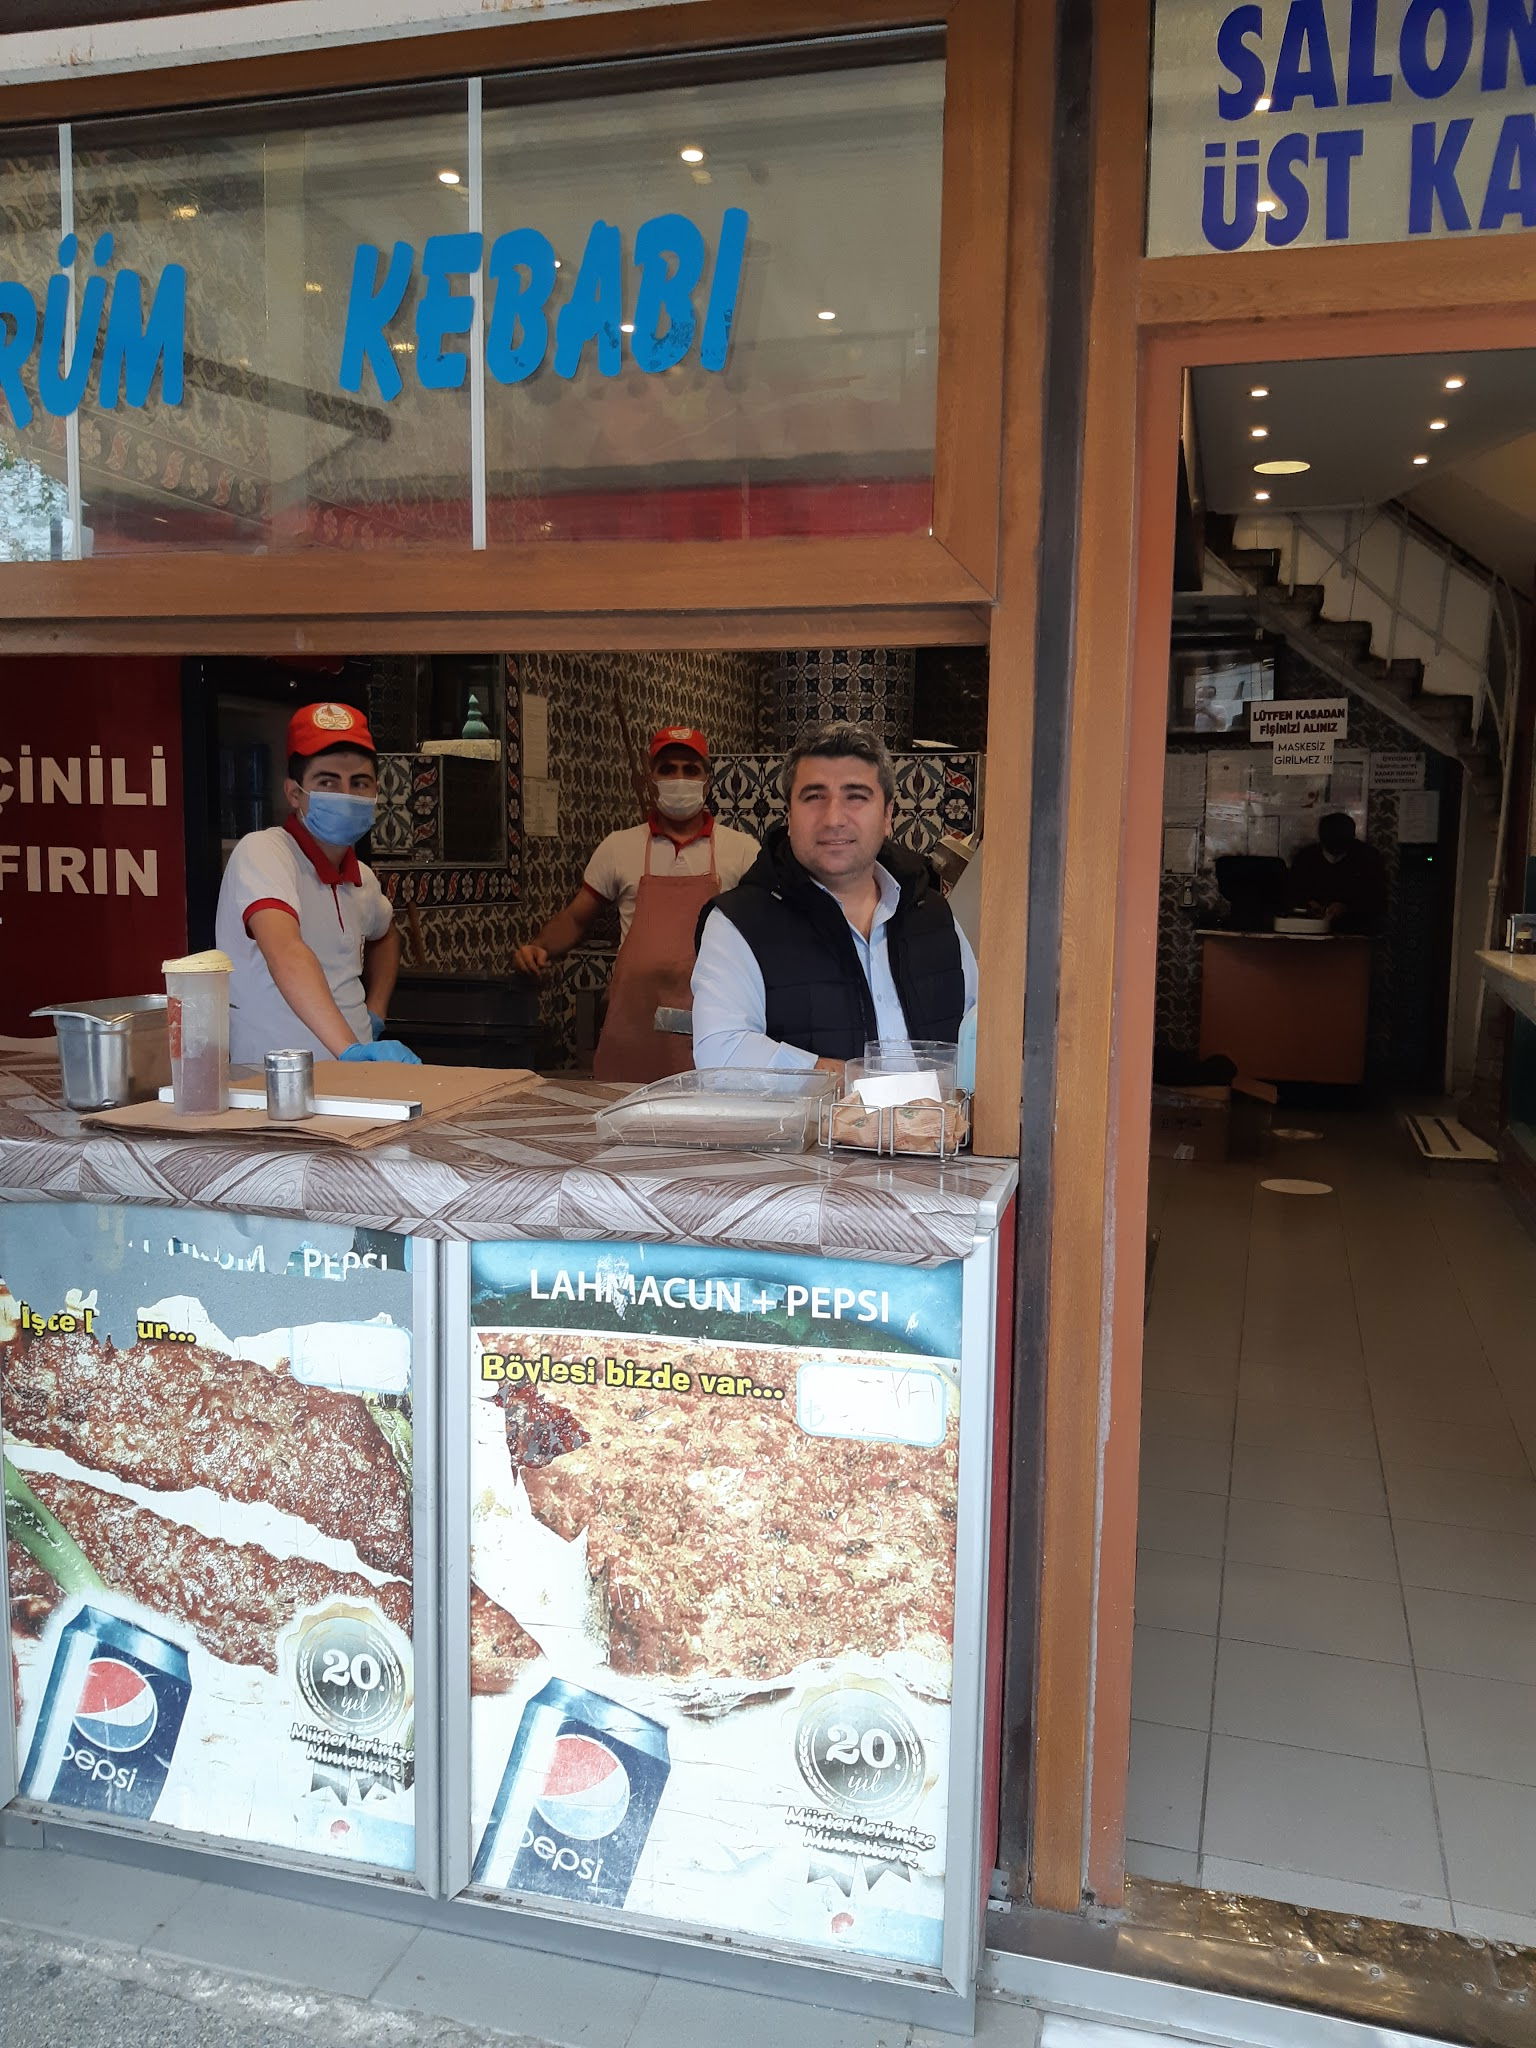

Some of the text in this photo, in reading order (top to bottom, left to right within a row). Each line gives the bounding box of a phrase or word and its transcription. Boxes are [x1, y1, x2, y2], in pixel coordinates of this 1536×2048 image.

[1202, 129, 1364, 252] ÜST
[339, 207, 749, 401] KEBABI
[1253, 708, 1345, 721] LÜTFEN KASADAN
[1260, 722, 1338, 737] FİŞİNİZİ ALINIZ
[1274, 755, 1320, 765] GİRİLMEZ
[1278, 741, 1326, 752] MASKESİZ
[0, 845, 158, 897] FIRIN
[530, 1268, 741, 1313] LAHMACUN
[787, 1285, 889, 1323] PEPSI
[482, 1353, 785, 1400] Böylesi bizde var...
[322, 1648, 385, 1692] 20.
[826, 1724, 901, 1771] 20.
